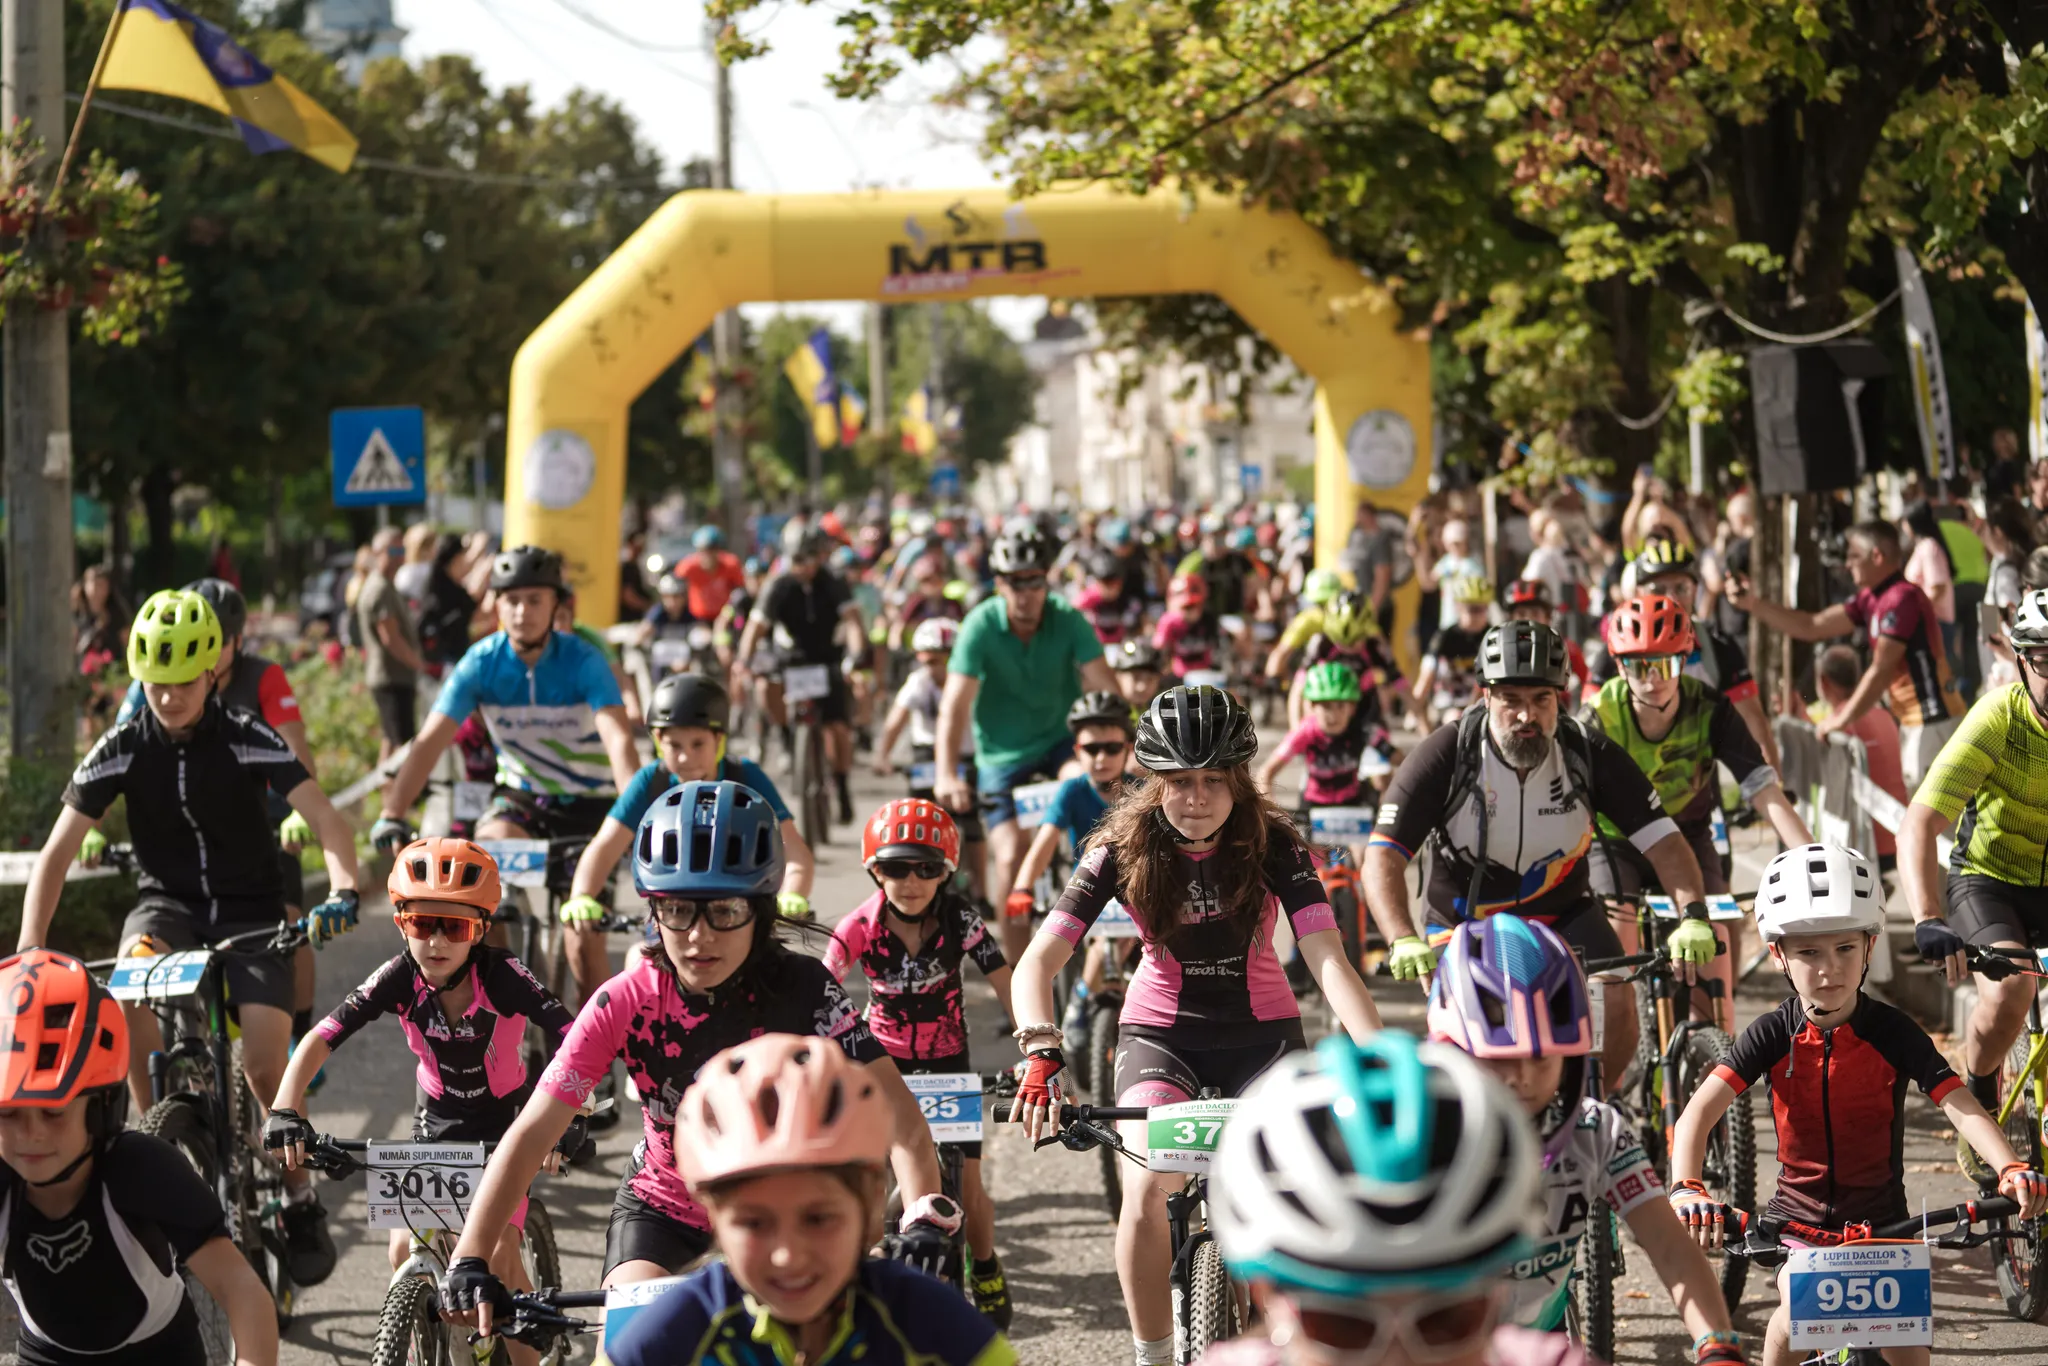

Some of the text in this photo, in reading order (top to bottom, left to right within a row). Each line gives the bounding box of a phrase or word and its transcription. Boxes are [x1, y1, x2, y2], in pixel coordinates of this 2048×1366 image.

[128, 967, 184, 986] 902
[412, 1150, 473, 1161] SUPLIMENTAR
[379, 1171, 470, 1199] 3016
[1823, 1250, 1896, 1261] LUPII DACILOR
[1816, 1276, 1901, 1312] 950
